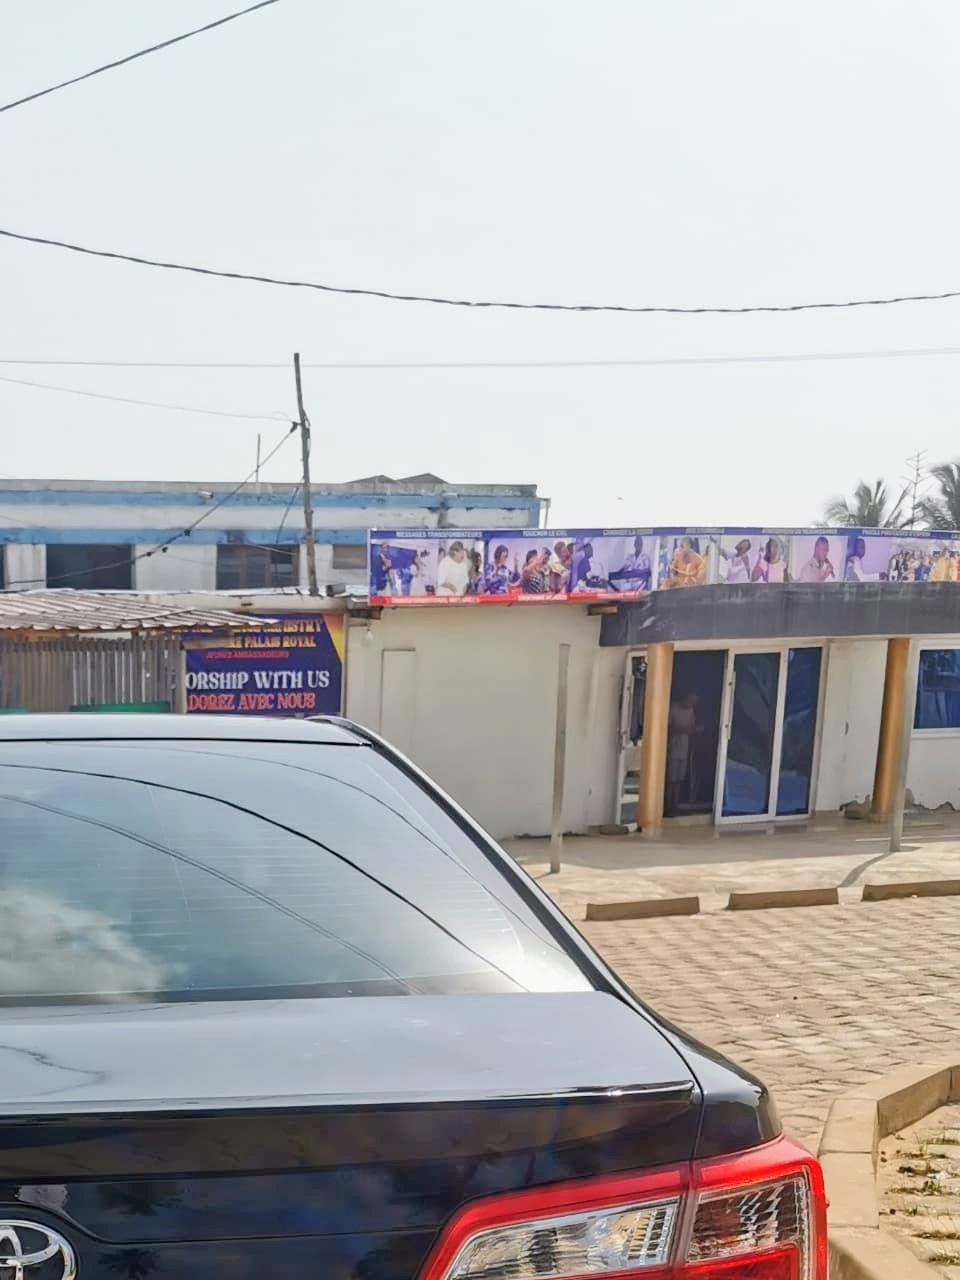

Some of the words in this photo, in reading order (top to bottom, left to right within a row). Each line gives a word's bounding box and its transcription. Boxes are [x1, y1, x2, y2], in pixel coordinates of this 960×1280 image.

[186, 671, 249, 690] ORSHIP
[253, 671, 303, 690] WITH
[307, 670, 330, 688] US
[187, 694, 235, 711] DOREZ
[238, 693, 275, 711] AVEC
